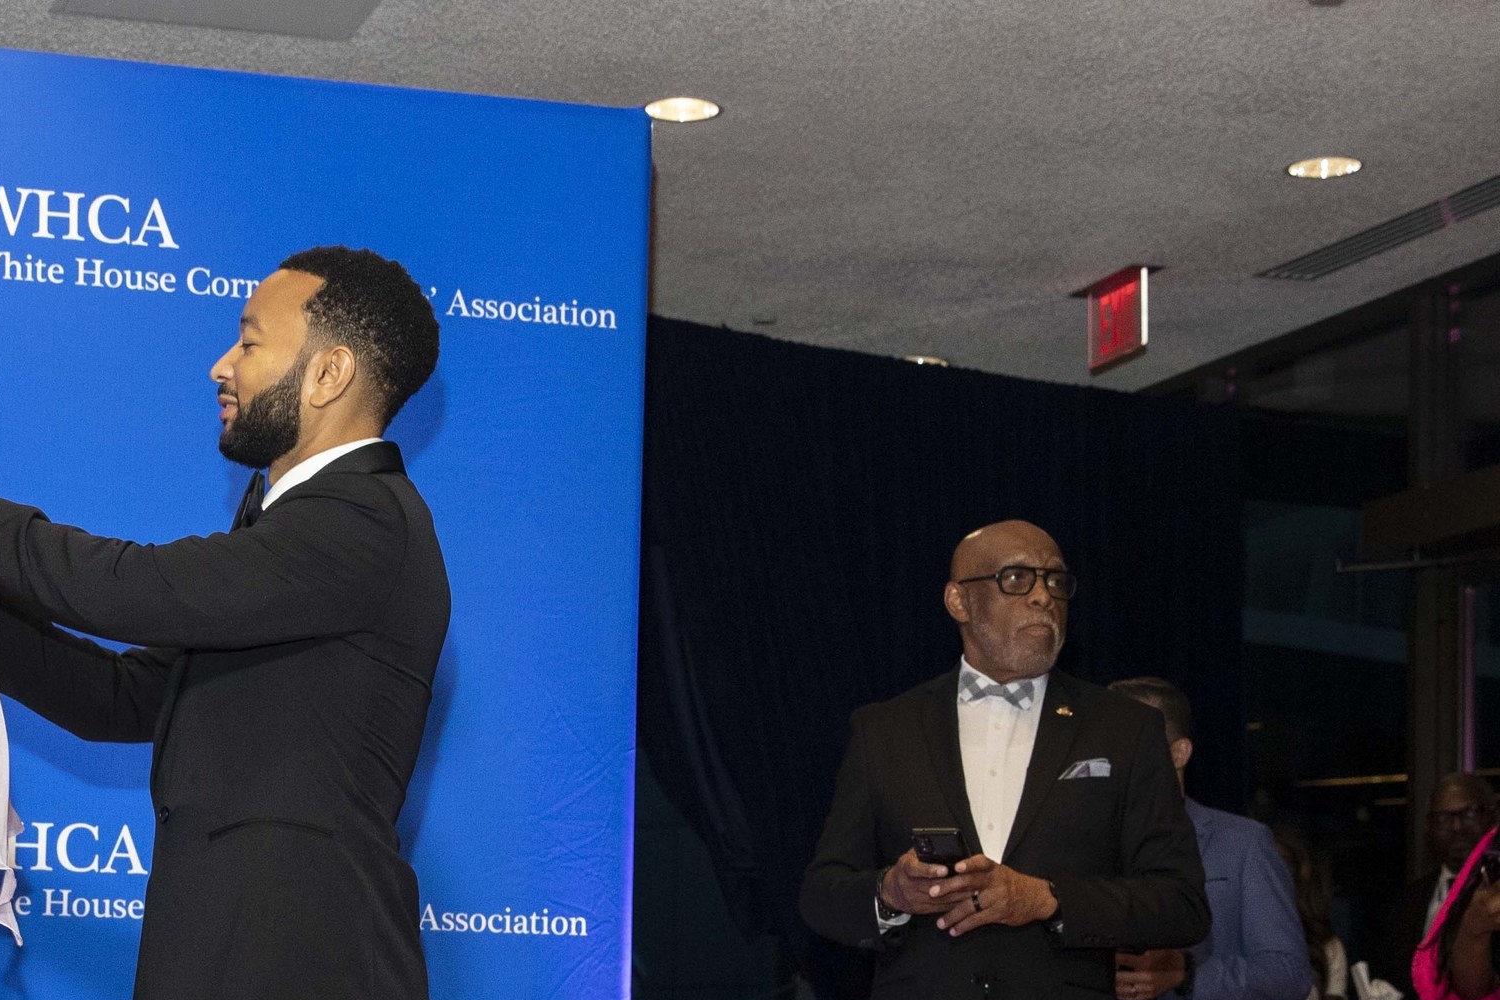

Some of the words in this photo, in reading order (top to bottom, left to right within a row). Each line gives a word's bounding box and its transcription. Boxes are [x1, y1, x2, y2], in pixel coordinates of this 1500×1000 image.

[74, 257, 177, 293] House
[445, 288, 617, 329] Association
[40, 885, 144, 921] House
[419, 903, 588, 937] Association
